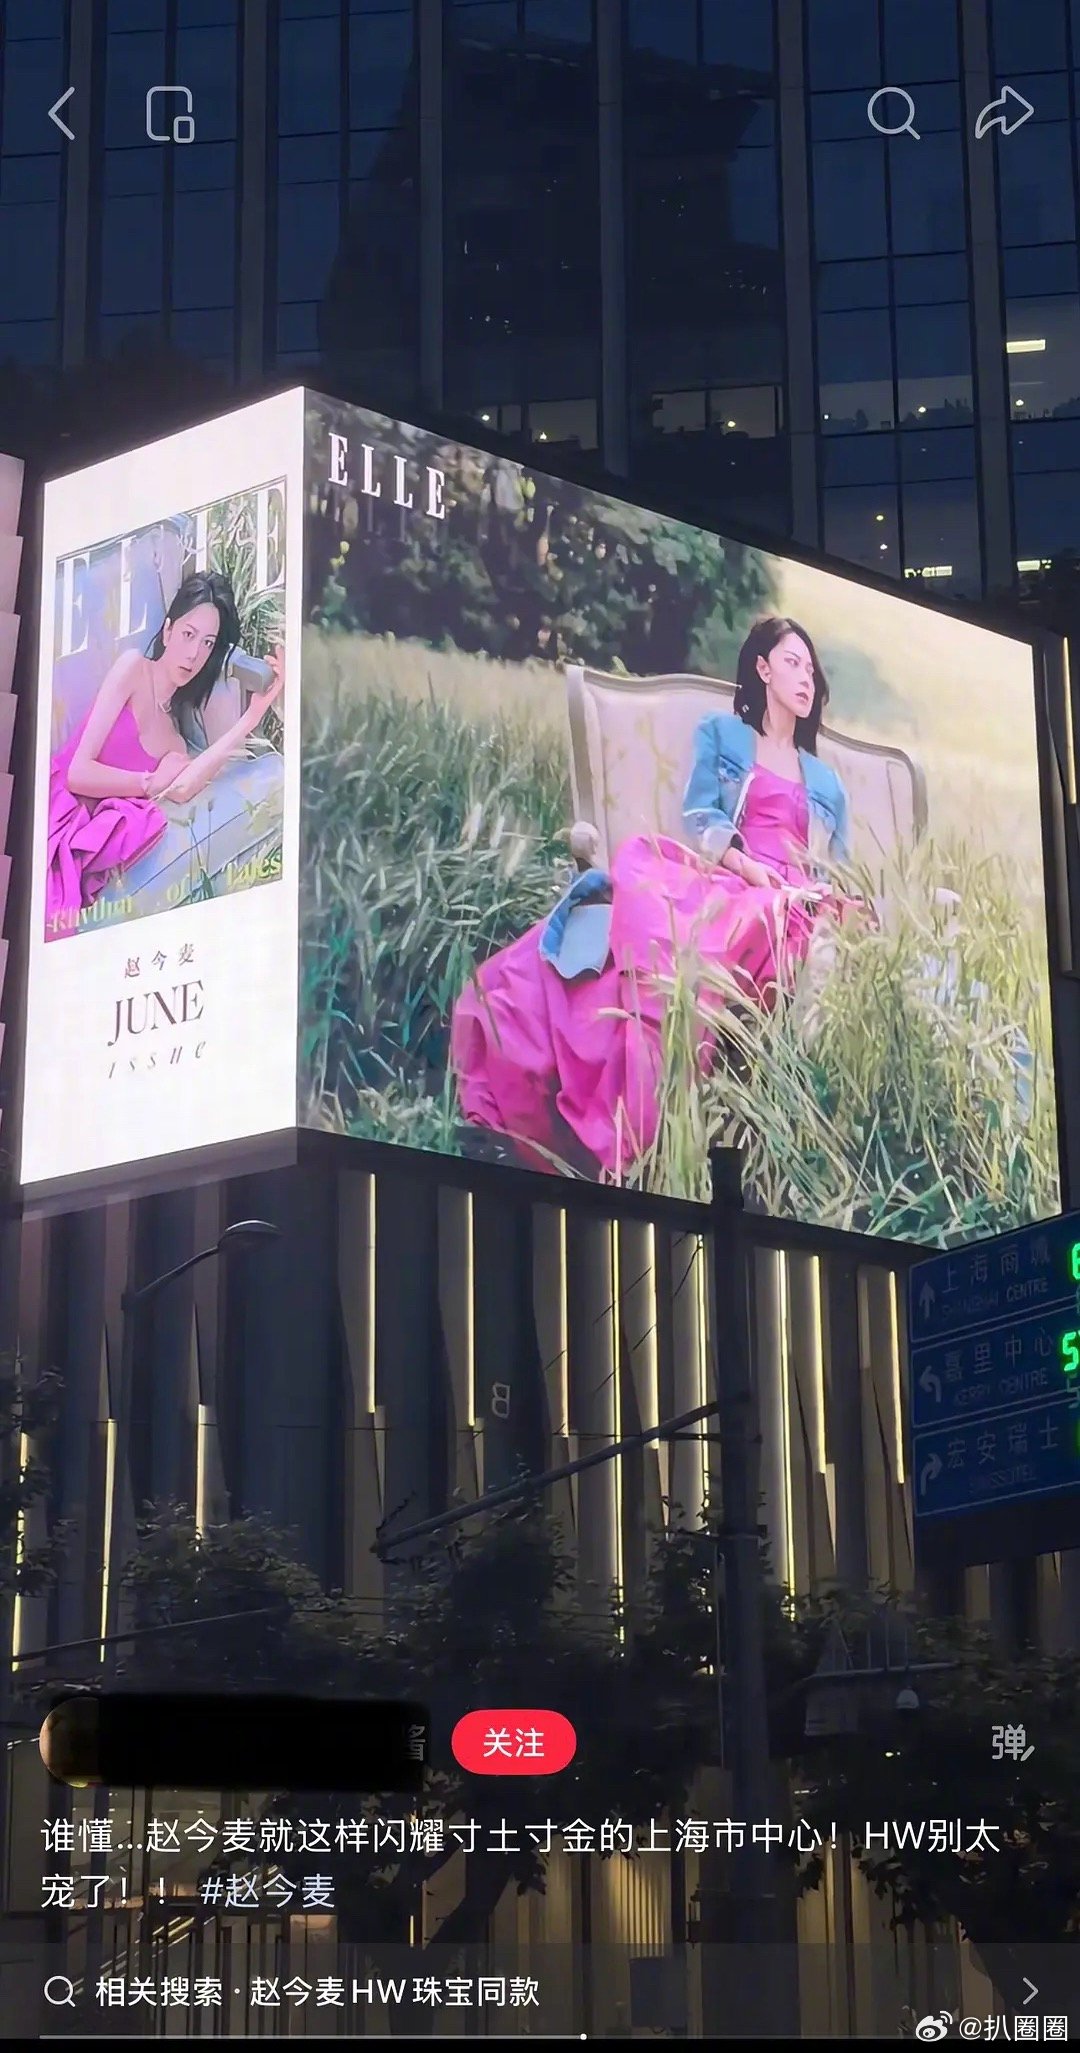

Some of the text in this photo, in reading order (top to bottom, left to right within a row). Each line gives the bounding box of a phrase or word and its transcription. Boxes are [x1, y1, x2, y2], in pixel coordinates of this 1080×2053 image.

[328, 432, 447, 519] ELLE
[56, 480, 286, 657] ELLE
[124, 943, 196, 979] 赵今麦
[107, 980, 205, 1047] JUNE
